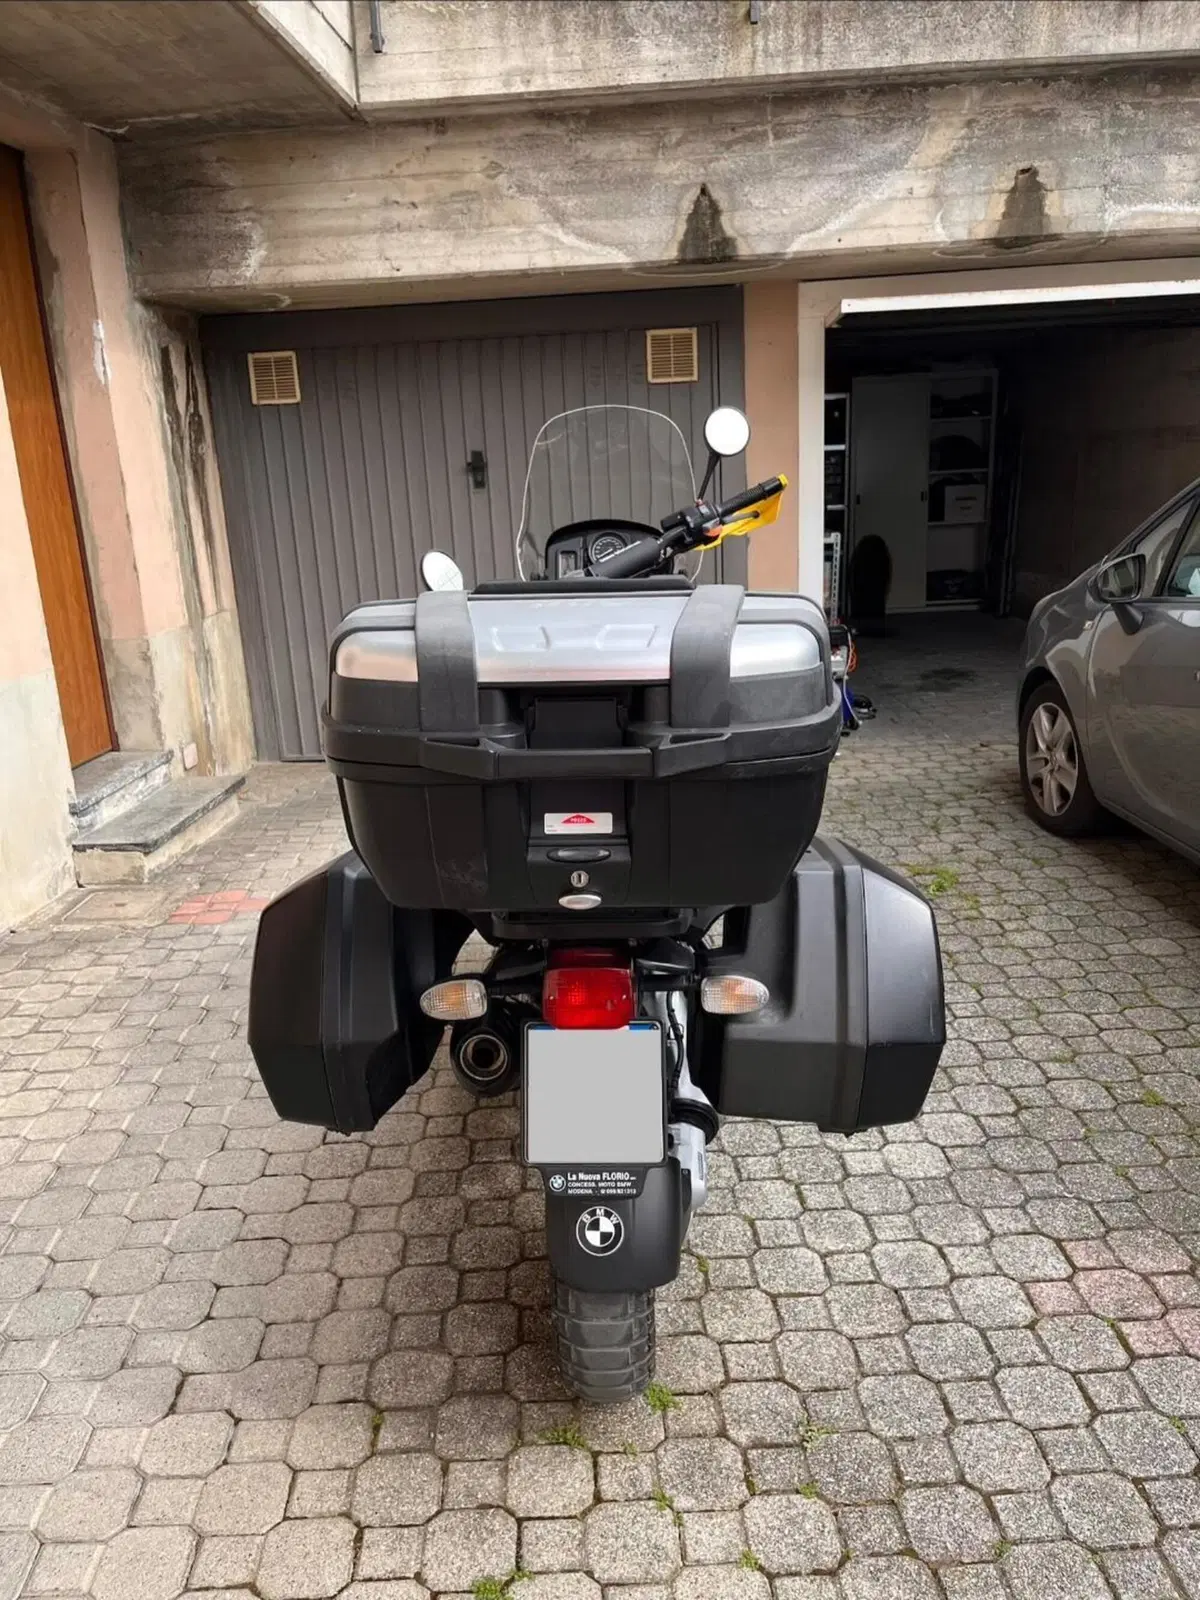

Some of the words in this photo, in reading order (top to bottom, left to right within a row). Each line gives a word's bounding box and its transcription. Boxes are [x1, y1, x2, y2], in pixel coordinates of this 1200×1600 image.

[567, 1172, 577, 1181] La
[578, 1172, 601, 1181] Nuova
[602, 1172, 630, 1181] FLORIO
[581, 1208, 620, 1224] BMW
